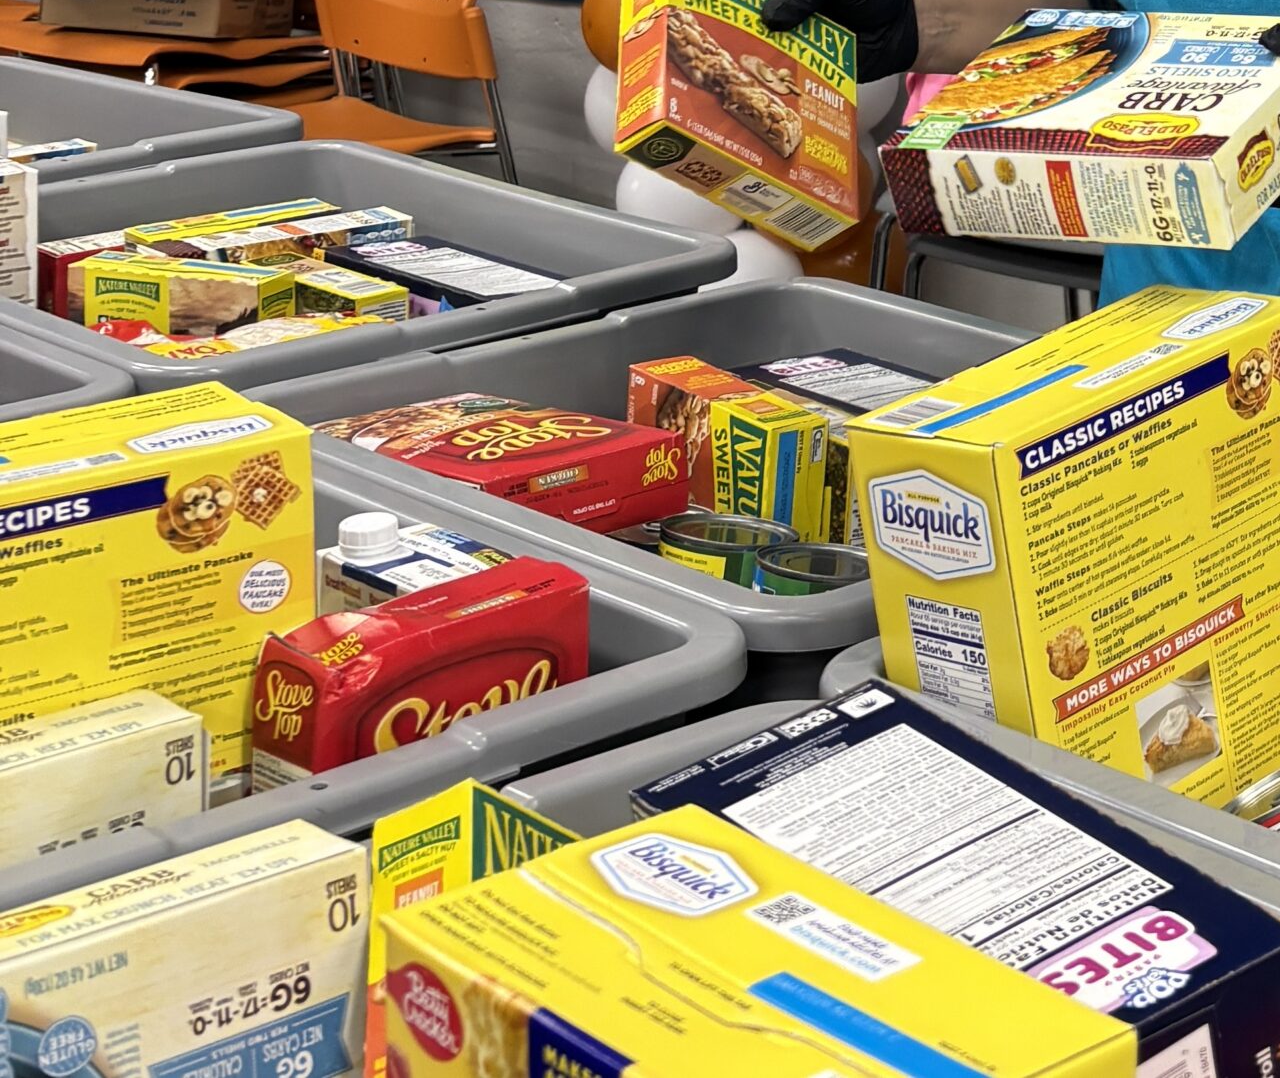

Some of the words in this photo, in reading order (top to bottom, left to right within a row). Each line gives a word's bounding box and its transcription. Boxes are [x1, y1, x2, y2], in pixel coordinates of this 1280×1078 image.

[743, 15, 751, 27] &
[756, 20, 808, 59] SALTY
[809, 52, 846, 89] NUT
[799, 17, 850, 67] LLEY
[1150, 67, 1209, 76] SHELLS
[1181, 53, 1207, 63] 90
[1217, 68, 1261, 77] TACO
[805, 79, 845, 111] PEANUT
[1118, 91, 1224, 111] CARB
[1126, 80, 1262, 94] Advantage
[97, 279, 130, 291] NATURE
[1185, 301, 1259, 335] Bisquick
[149, 421, 257, 450] Bisquick
[450, 418, 523, 447] Top
[467, 416, 612, 461] Stove
[1024, 420, 1107, 470] CLASSIC
[1111, 380, 1185, 430] RECIPES
[646, 444, 665, 464] Top
[1020, 472, 1062, 497] Classic
[1064, 446, 1115, 477] Pancakes
[1118, 439, 1129, 451] or
[1132, 418, 1172, 443] Waffles
[1211, 445, 1225, 455] The
[641, 448, 681, 486] Stove
[714, 428, 731, 508] SWEET
[733, 424, 762, 516] NATU
[881, 489, 981, 542] Bisquick
[891, 535, 923, 548] PANCAKE
[933, 545, 960, 554] BAKING
[962, 550, 977, 558] MIX
[1028, 528, 1065, 550] Pancake
[1067, 515, 1091, 532] Steps
[121, 577, 142, 588] The
[147, 563, 201, 581] Ultimate
[204, 550, 253, 569] Pancake
[1035, 578, 1065, 597] Waffle
[1066, 565, 1091, 581] Steps
[909, 598, 948, 615] Nutrition
[953, 609, 979, 622] Facts
[1091, 597, 1130, 621] Classic
[1132, 572, 1173, 600] Biscuits
[1174, 604, 1237, 653] BISQUICK
[916, 641, 953, 658] Calories
[962, 650, 986, 665] 150
[1066, 679, 1108, 712] MORE
[1111, 656, 1150, 686] WAYS
[1154, 644, 1172, 662] TO
[1130, 672, 1162, 695] Coconut
[255, 670, 314, 721] Stove
[273, 707, 302, 741] Top
[166, 735, 193, 755] SHELLS
[165, 754, 195, 785] 10
[420, 820, 459, 847] VALLEY
[87, 868, 174, 898] CARB
[629, 841, 730, 900] Bisquick
[327, 874, 356, 898] SHELLS
[328, 895, 360, 931] 10
[1041, 914, 1191, 997] BITES
[50, 1029, 84, 1049] FREE
[264, 1033, 300, 1062] CARBS
[302, 1025, 323, 1047] NET
[39, 1038, 96, 1065] GLUTEN
[276, 1050, 314, 1078] 6G
